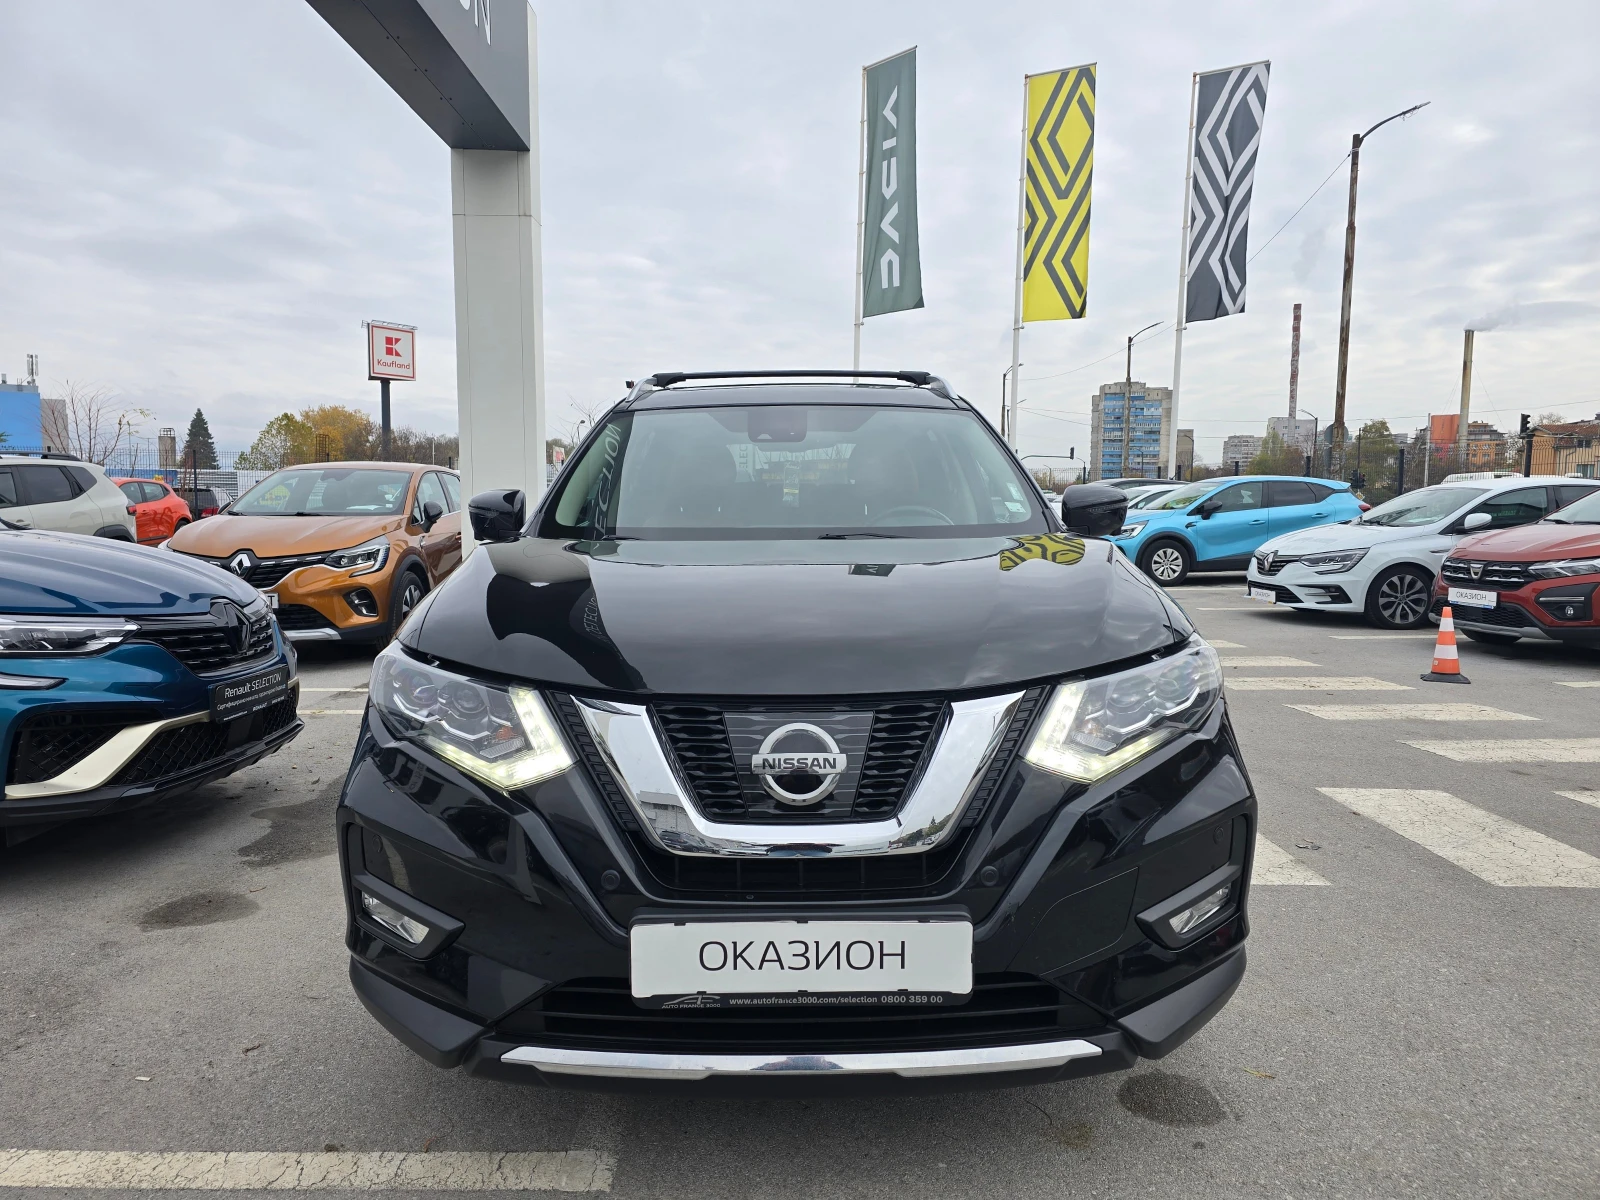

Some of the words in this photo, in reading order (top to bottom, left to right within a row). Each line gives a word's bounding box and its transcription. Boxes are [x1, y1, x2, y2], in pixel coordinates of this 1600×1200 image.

[880, 84, 900, 290] DACIA
[377, 359, 411, 370] Kaufland
[1456, 591, 1487, 601] ОКАЗИОН
[224, 682, 251, 699] Renault
[251, 672, 282, 691] SELECTION
[762, 757, 837, 770] NISSAN
[699, 940, 906, 972] ОКАЗИОН
[729, 995, 878, 1005] www.autofrance3000.com/selection
[881, 995, 906, 1003] 0800
[908, 995, 928, 1003] 359
[930, 995, 943, 1003] 00
